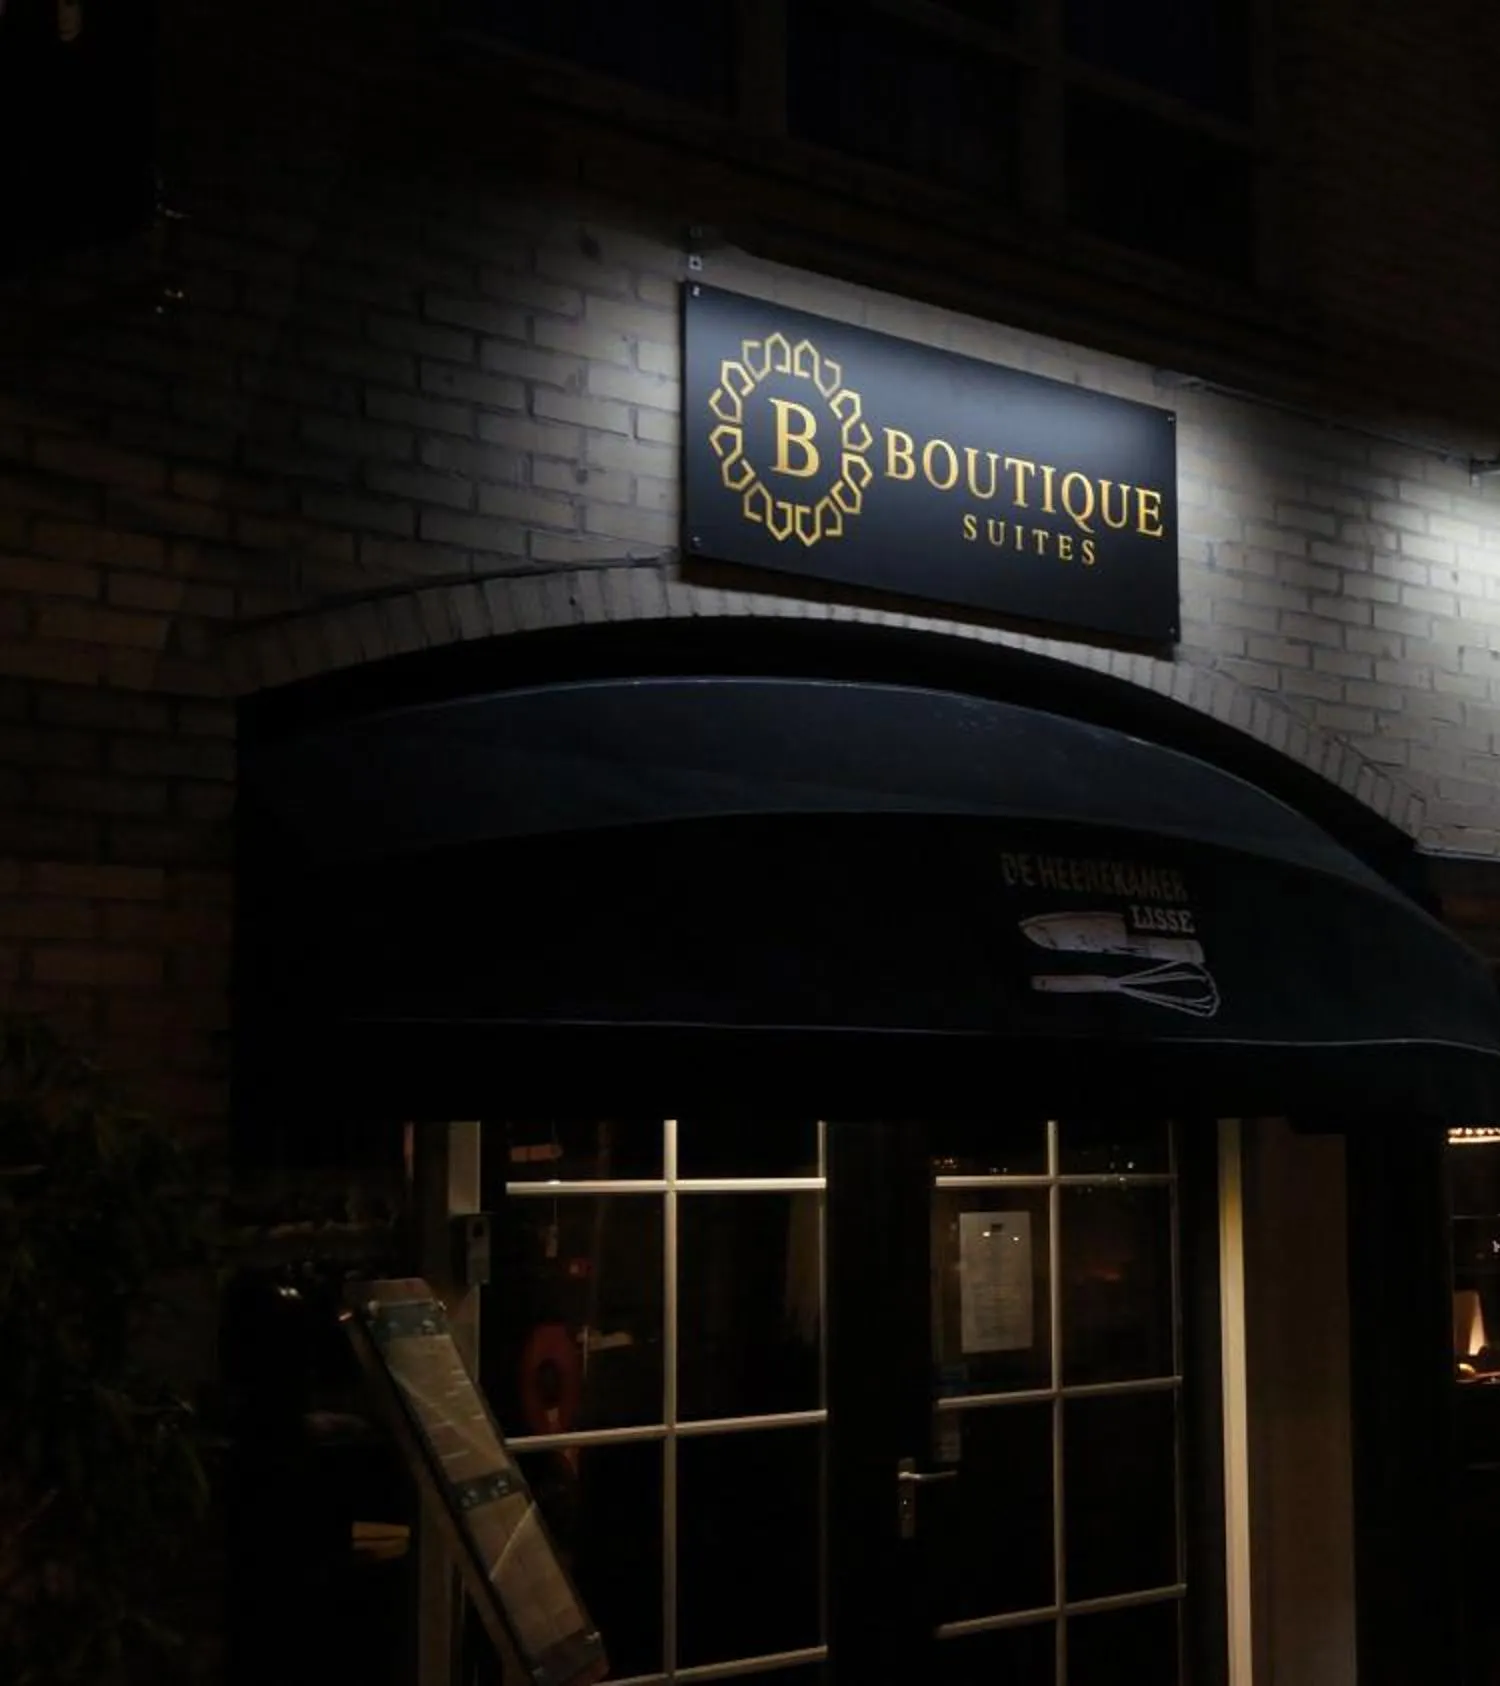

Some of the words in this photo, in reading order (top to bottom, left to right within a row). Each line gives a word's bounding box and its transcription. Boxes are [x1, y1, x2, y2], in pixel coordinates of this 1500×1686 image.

[767, 397, 821, 479] B
[882, 427, 1165, 539] BOUTIQUE
[962, 512, 1097, 566] SUITES
[1000, 851, 1036, 888] DE
[1129, 903, 1197, 935] LISSE
